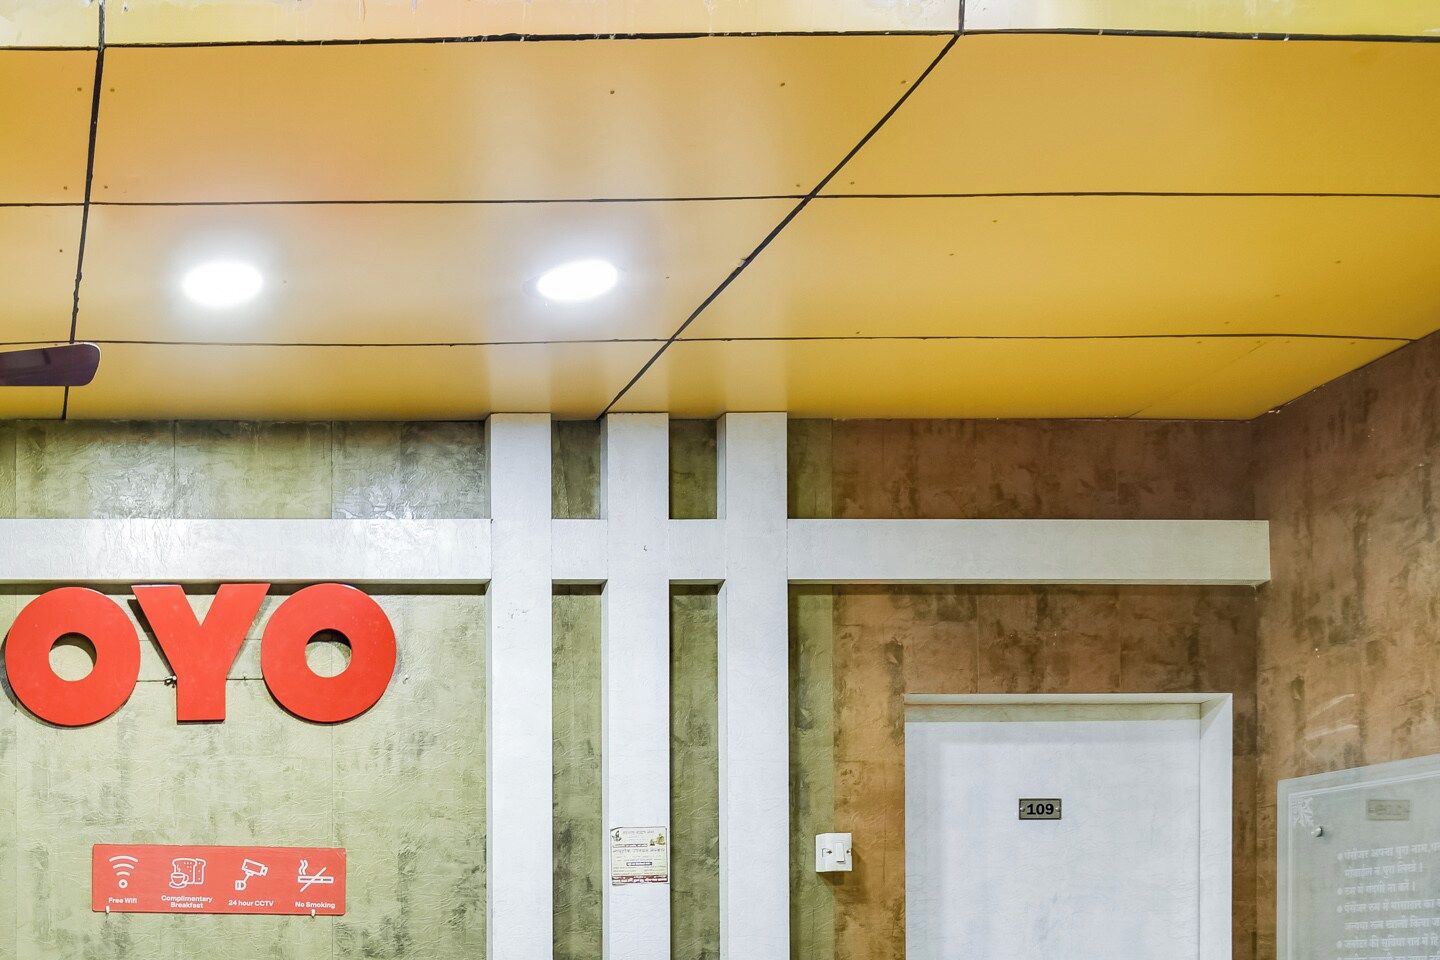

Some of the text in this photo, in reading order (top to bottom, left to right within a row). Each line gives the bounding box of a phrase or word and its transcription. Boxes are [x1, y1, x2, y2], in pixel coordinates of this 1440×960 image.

[4, 583, 397, 727] OYO
[1026, 803, 1055, 815] 109
[108, 896, 124, 904] Free
[161, 894, 213, 903] Complimentary
[305, 901, 336, 909] Smoking
